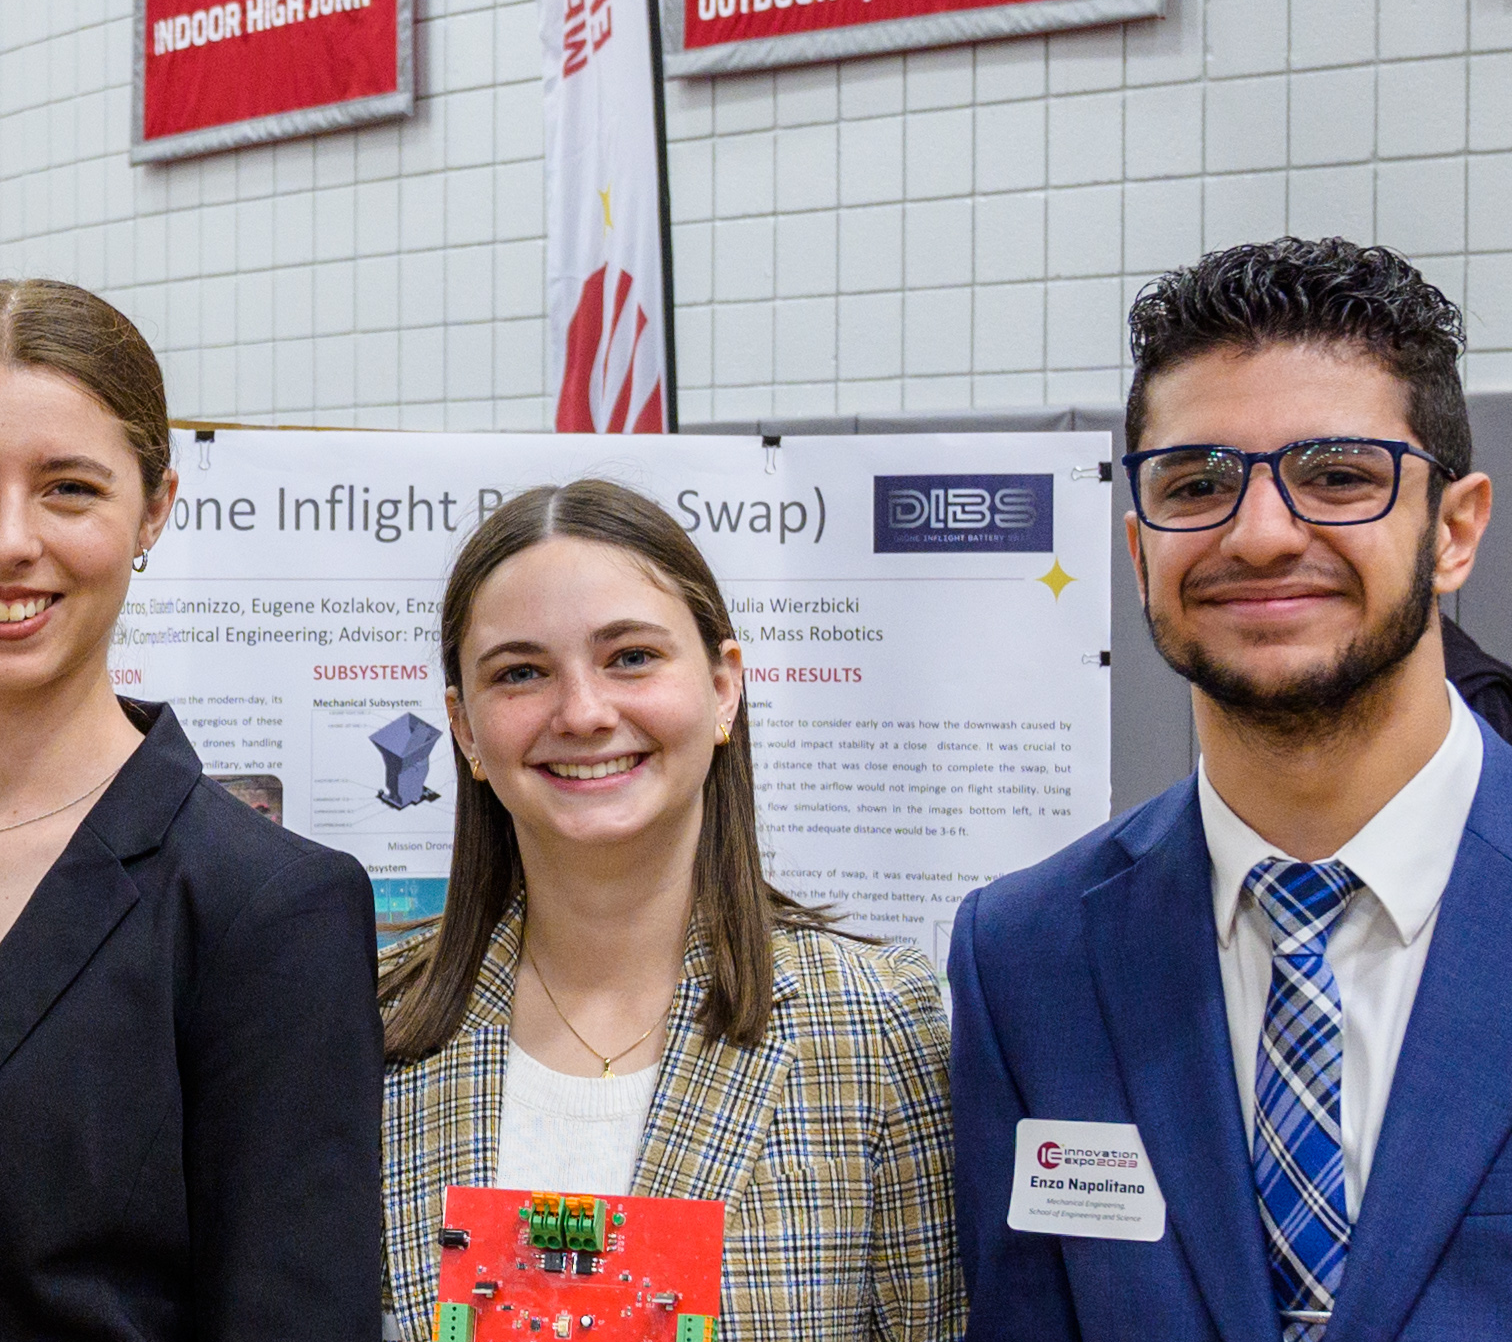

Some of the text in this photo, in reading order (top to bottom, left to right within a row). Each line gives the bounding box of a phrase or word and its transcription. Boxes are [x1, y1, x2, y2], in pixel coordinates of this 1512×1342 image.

[153, 0, 242, 56] INDOOR
[169, 496, 256, 531] one
[279, 484, 457, 543] Inflight
[676, 486, 826, 544] Swap)
[888, 488, 1037, 528] DIBS
[923, 534, 965, 542] INFLIGHT
[967, 533, 1004, 542] BATTERY
[176, 597, 245, 616] Cannizzo,
[252, 597, 315, 616] Eugene
[321, 597, 400, 615] Kozlakov,
[729, 597, 860, 613] Julia Wierzbicki
[226, 626, 333, 647] Engineering;
[338, 626, 407, 642] Advisor:
[760, 625, 884, 641] Mass Robotics
[312, 664, 428, 680] SUBSYSTEMS
[786, 667, 862, 682] RESULTS
[312, 697, 422, 709] Mechanical Subsystem:
[1064, 1148, 1139, 1160] innovation
[1029, 1175, 1145, 1195] Enzo Napolitano
